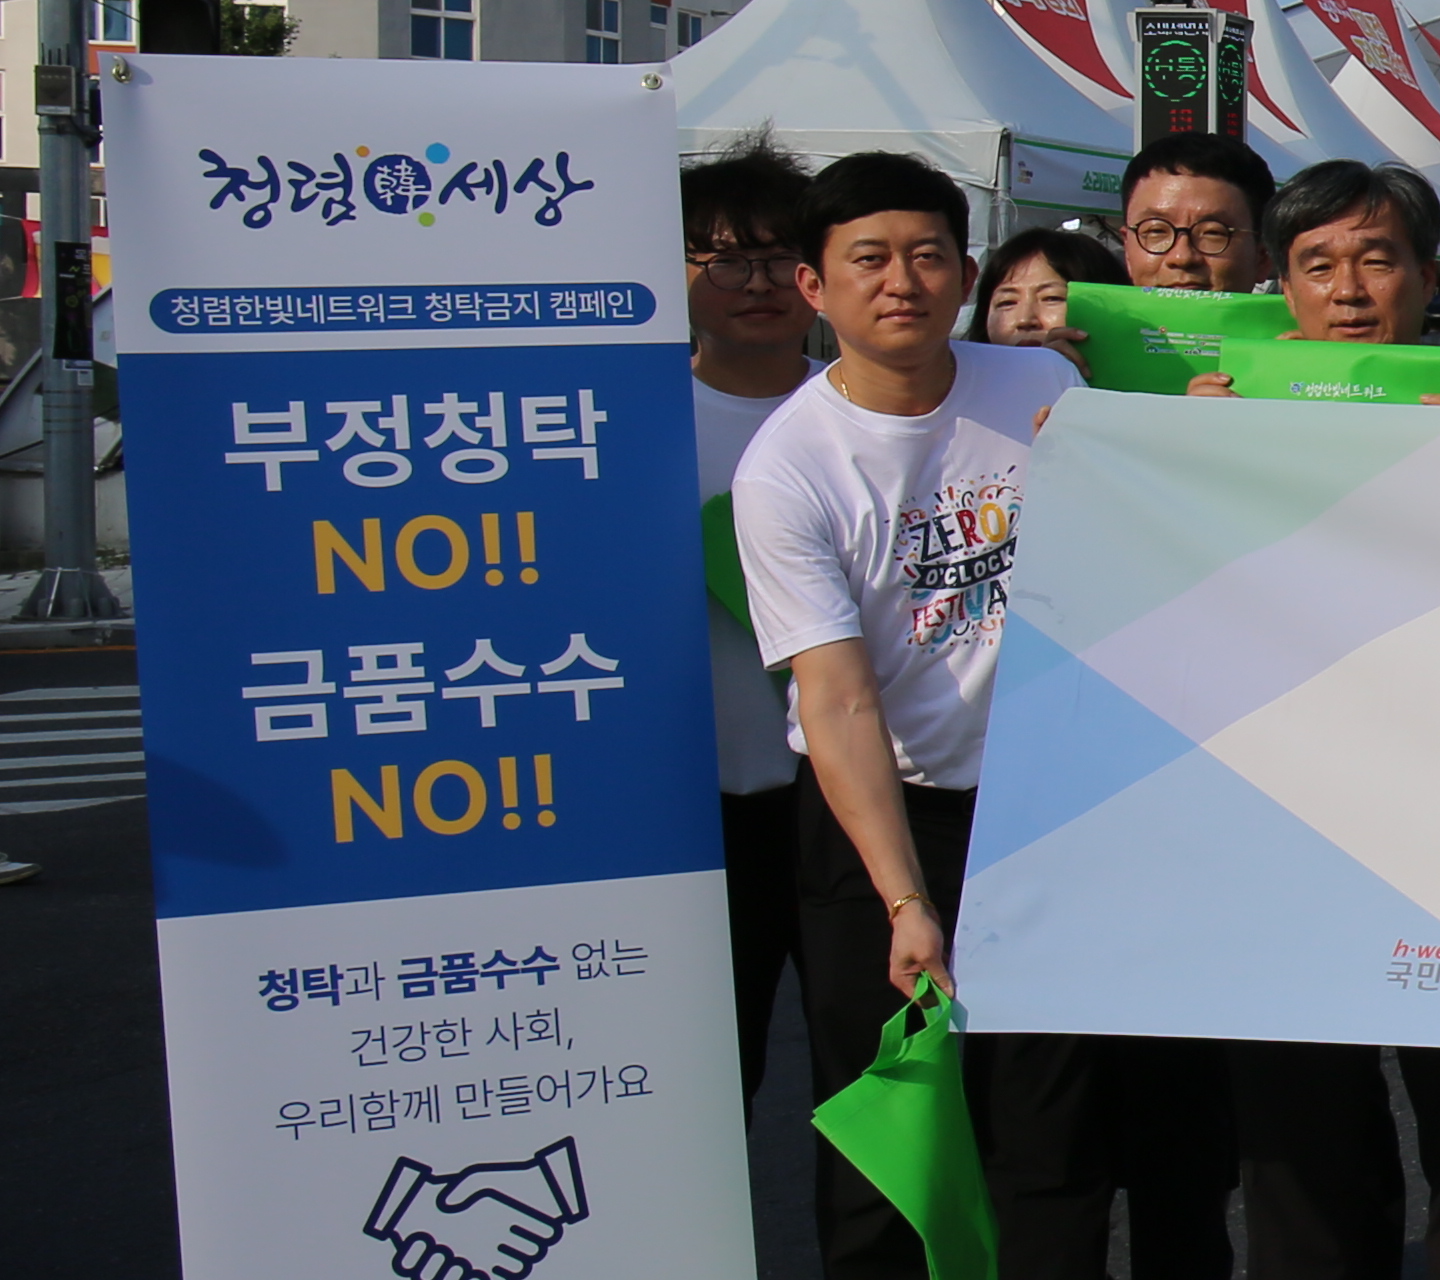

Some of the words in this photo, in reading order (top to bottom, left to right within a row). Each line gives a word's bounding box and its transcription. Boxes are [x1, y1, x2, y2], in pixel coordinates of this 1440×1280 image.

[169, 293, 417, 328] 청렴한빛네트워크
[425, 291, 541, 323] 청탁금지
[549, 289, 636, 321] 캠페인
[224, 388, 608, 493] 부정청탁
[312, 510, 541, 596] NO!!
[908, 502, 1008, 563] ZERO
[925, 547, 1015, 586] O'CLOCK
[241, 632, 626, 744] 금품수수
[330, 753, 559, 844] NO!!
[257, 960, 386, 1013] 청탁과
[396, 945, 561, 1000] 금품수수
[570, 937, 650, 982] 없는
[349, 1016, 473, 1069] 건강한
[484, 1006, 575, 1059] 사회,
[274, 1084, 442, 1141] 우리함께
[455, 1062, 654, 1122] 만들어가요
